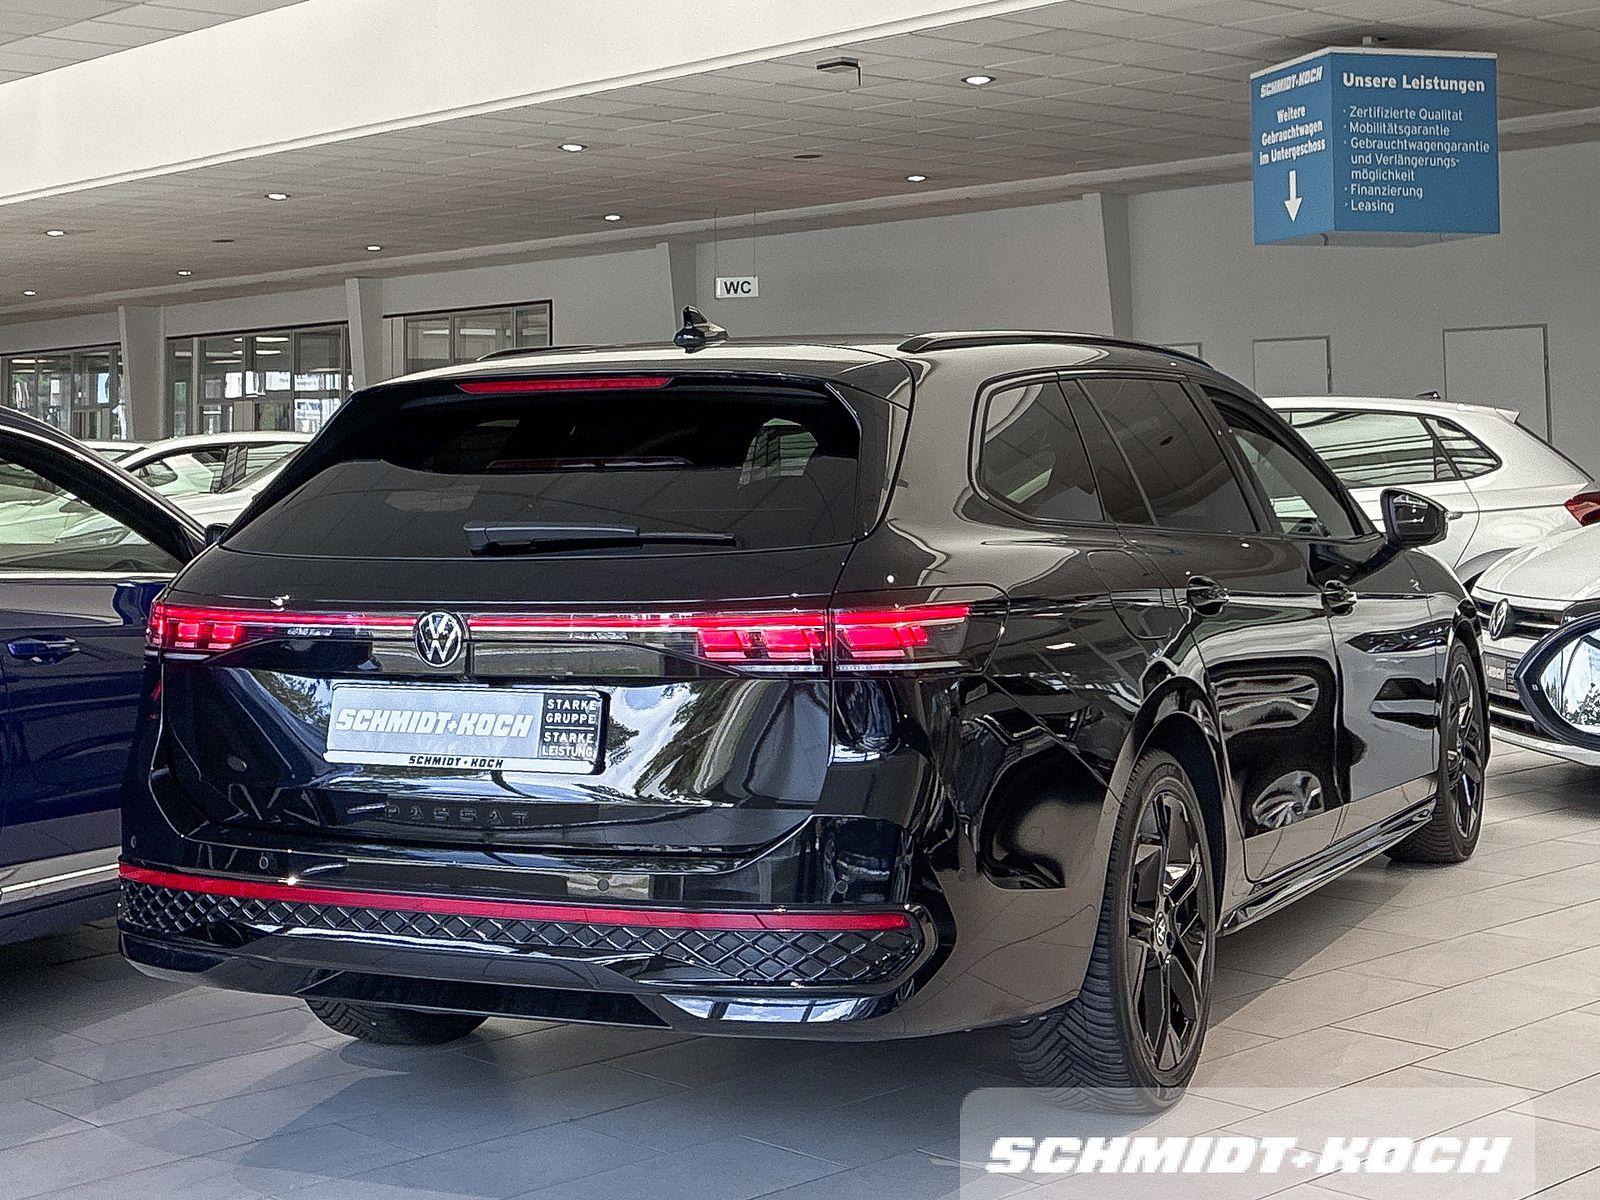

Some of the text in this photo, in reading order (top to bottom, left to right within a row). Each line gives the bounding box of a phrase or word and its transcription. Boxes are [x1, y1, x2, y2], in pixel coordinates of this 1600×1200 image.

[1342, 72, 1485, 94] Unsere Leistungen
[1276, 106, 1306, 123] Weitere
[1349, 105, 1416, 120] Zertifizierte
[1261, 120, 1323, 146] Gebrauchtwagen
[1349, 121, 1450, 137] Mobilitätsgarantie
[1260, 139, 1326, 165] im Untergeschoss
[1350, 137, 1490, 154] Gebrauchtwagengarantie
[1351, 153, 1372, 165] und
[1351, 169, 1415, 183] möglichkeit
[1351, 184, 1423, 199] Finanzierung
[1351, 200, 1394, 213] Leasing
[723, 280, 752, 295] WC
[547, 698, 598, 711] STARKE
[545, 712, 597, 725] GRUPPE
[543, 731, 595, 744] STARKE
[542, 744, 594, 758] LEISTUNG
[408, 755, 462, 767] SCHMIDT
[470, 757, 504, 769] KOCH
[383, 804, 529, 826] PASSAT
